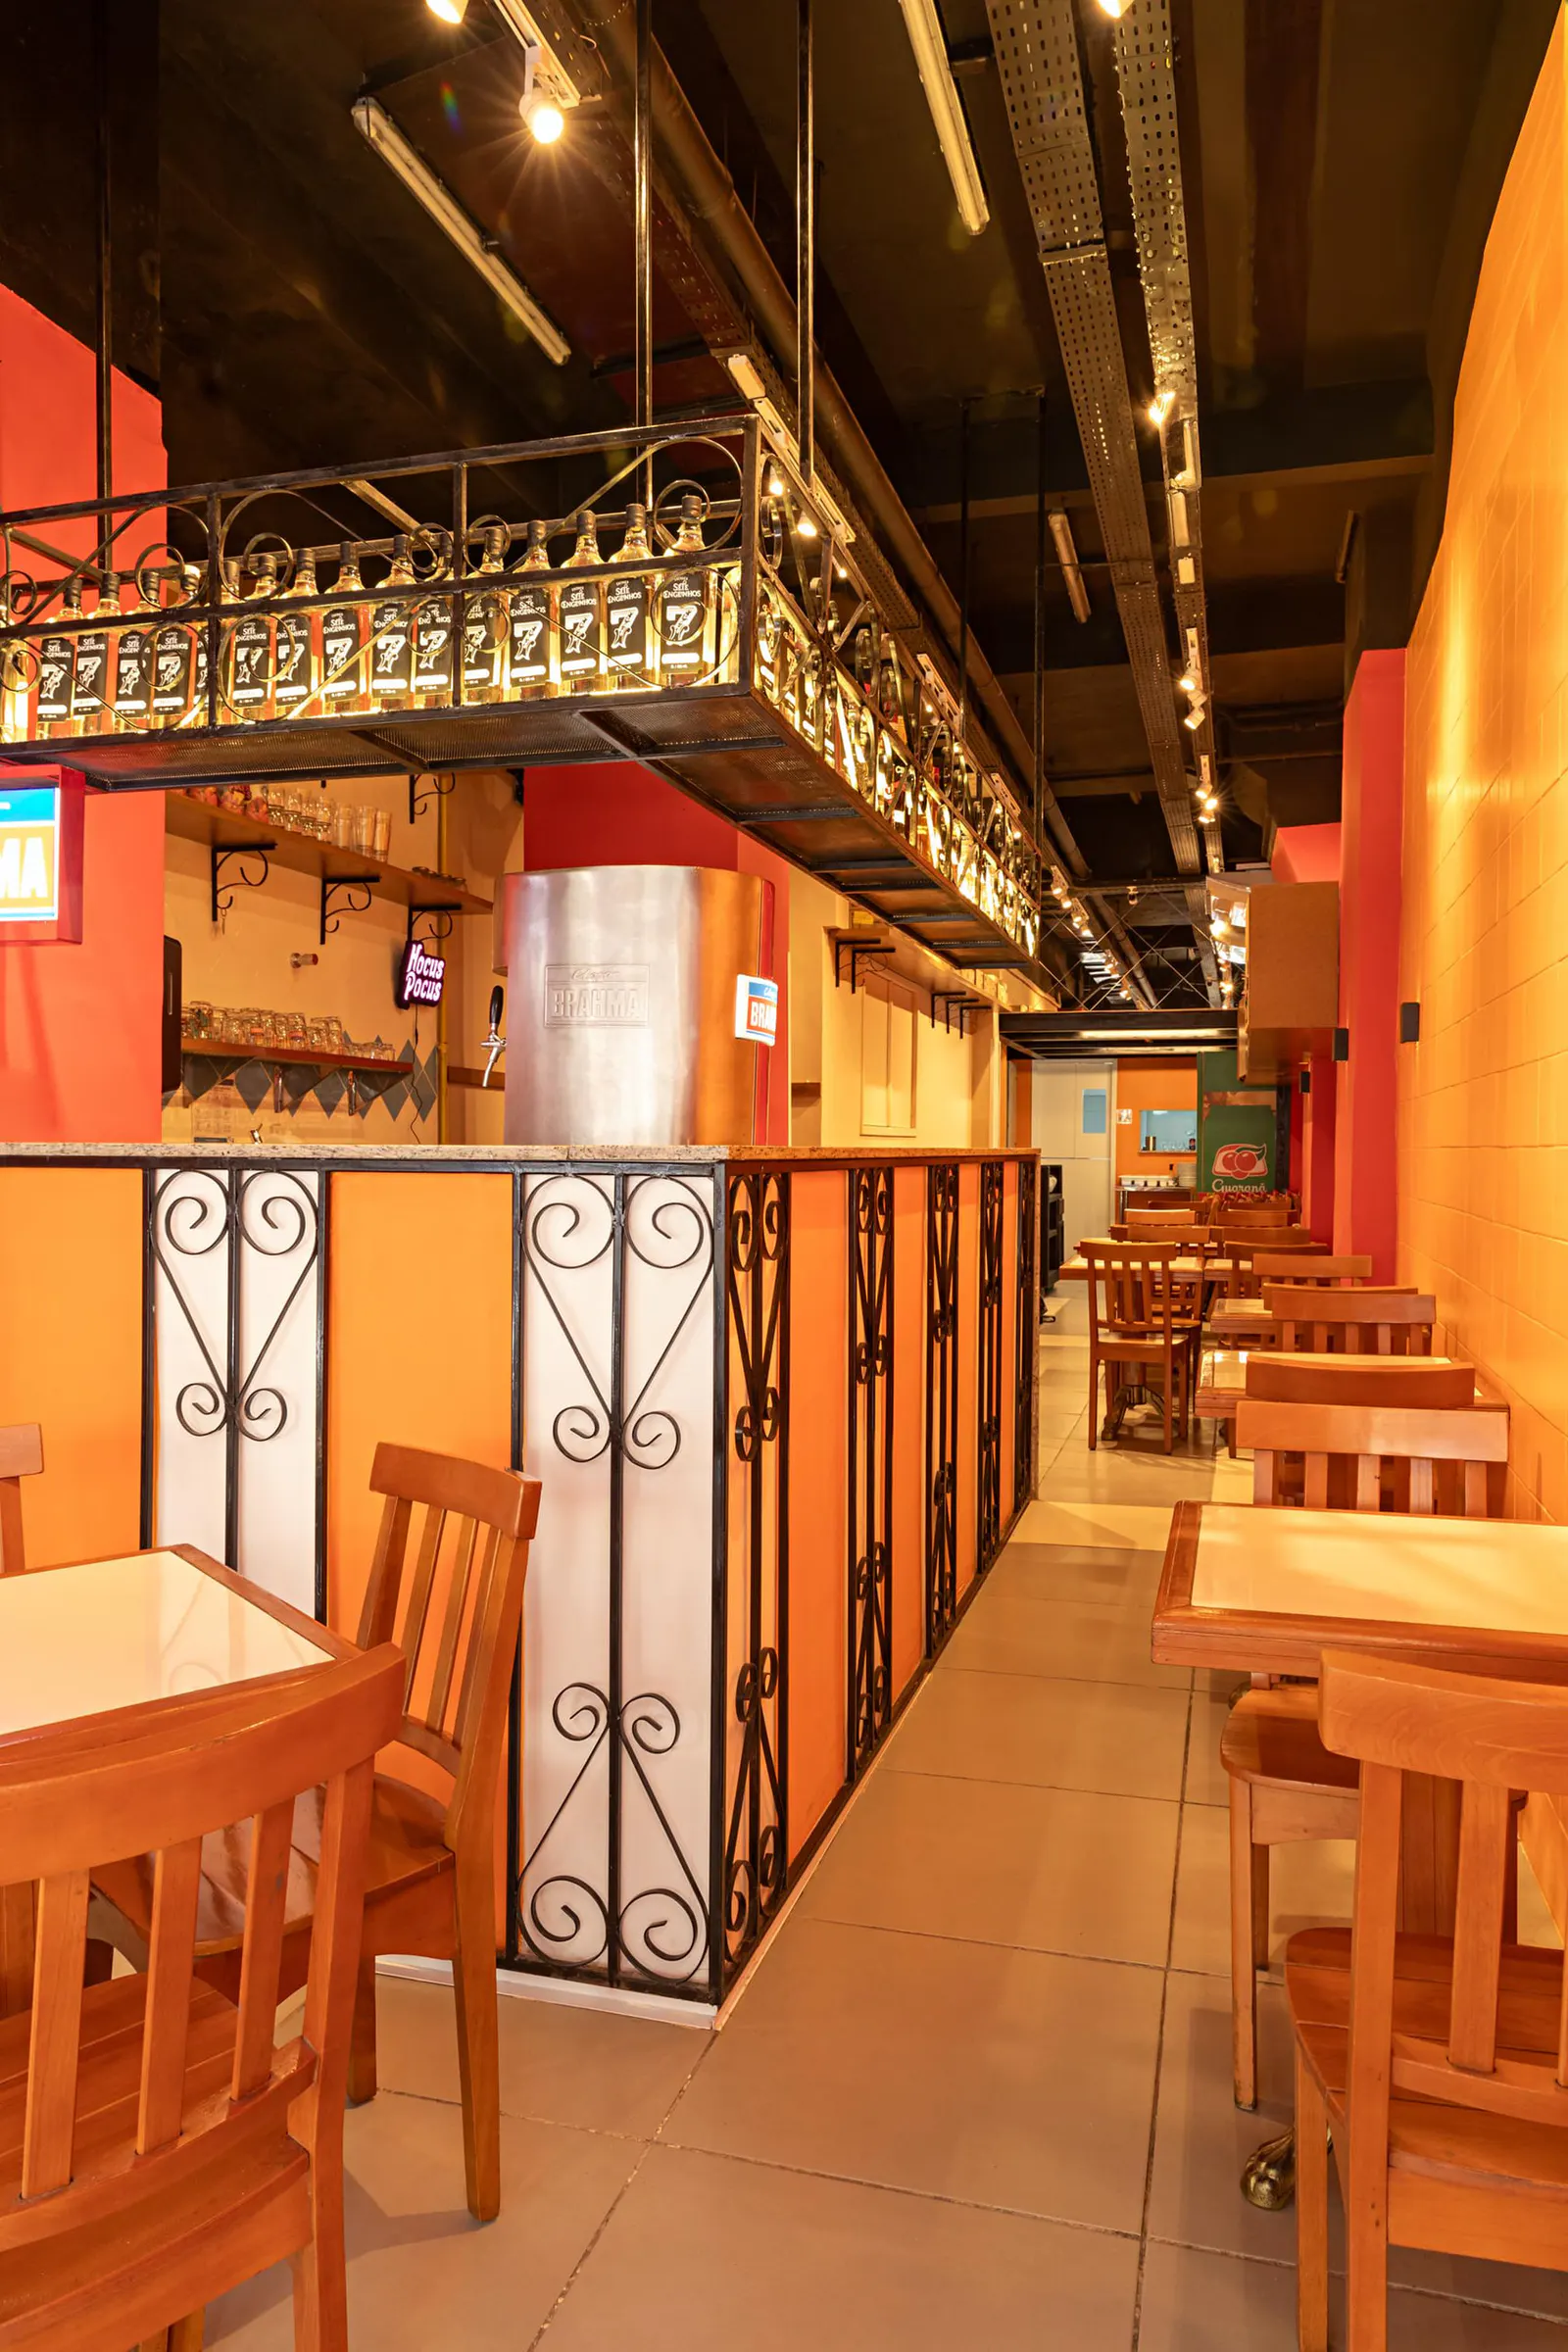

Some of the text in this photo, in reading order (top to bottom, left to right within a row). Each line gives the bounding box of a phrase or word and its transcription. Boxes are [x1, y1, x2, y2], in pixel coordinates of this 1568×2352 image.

[514, 620, 543, 661] 7
[564, 612, 594, 654] 7
[610, 607, 639, 649] 7
[666, 605, 698, 647] 7
[325, 637, 353, 676] 7
[376, 634, 407, 673] 7
[418, 630, 447, 669] 7
[40, 664, 67, 699] 7
[76, 657, 101, 692] 7
[407, 944, 445, 980] HOCUS
[404, 971, 442, 1002] POCUS
[551, 988, 640, 1018] BRAHMA
